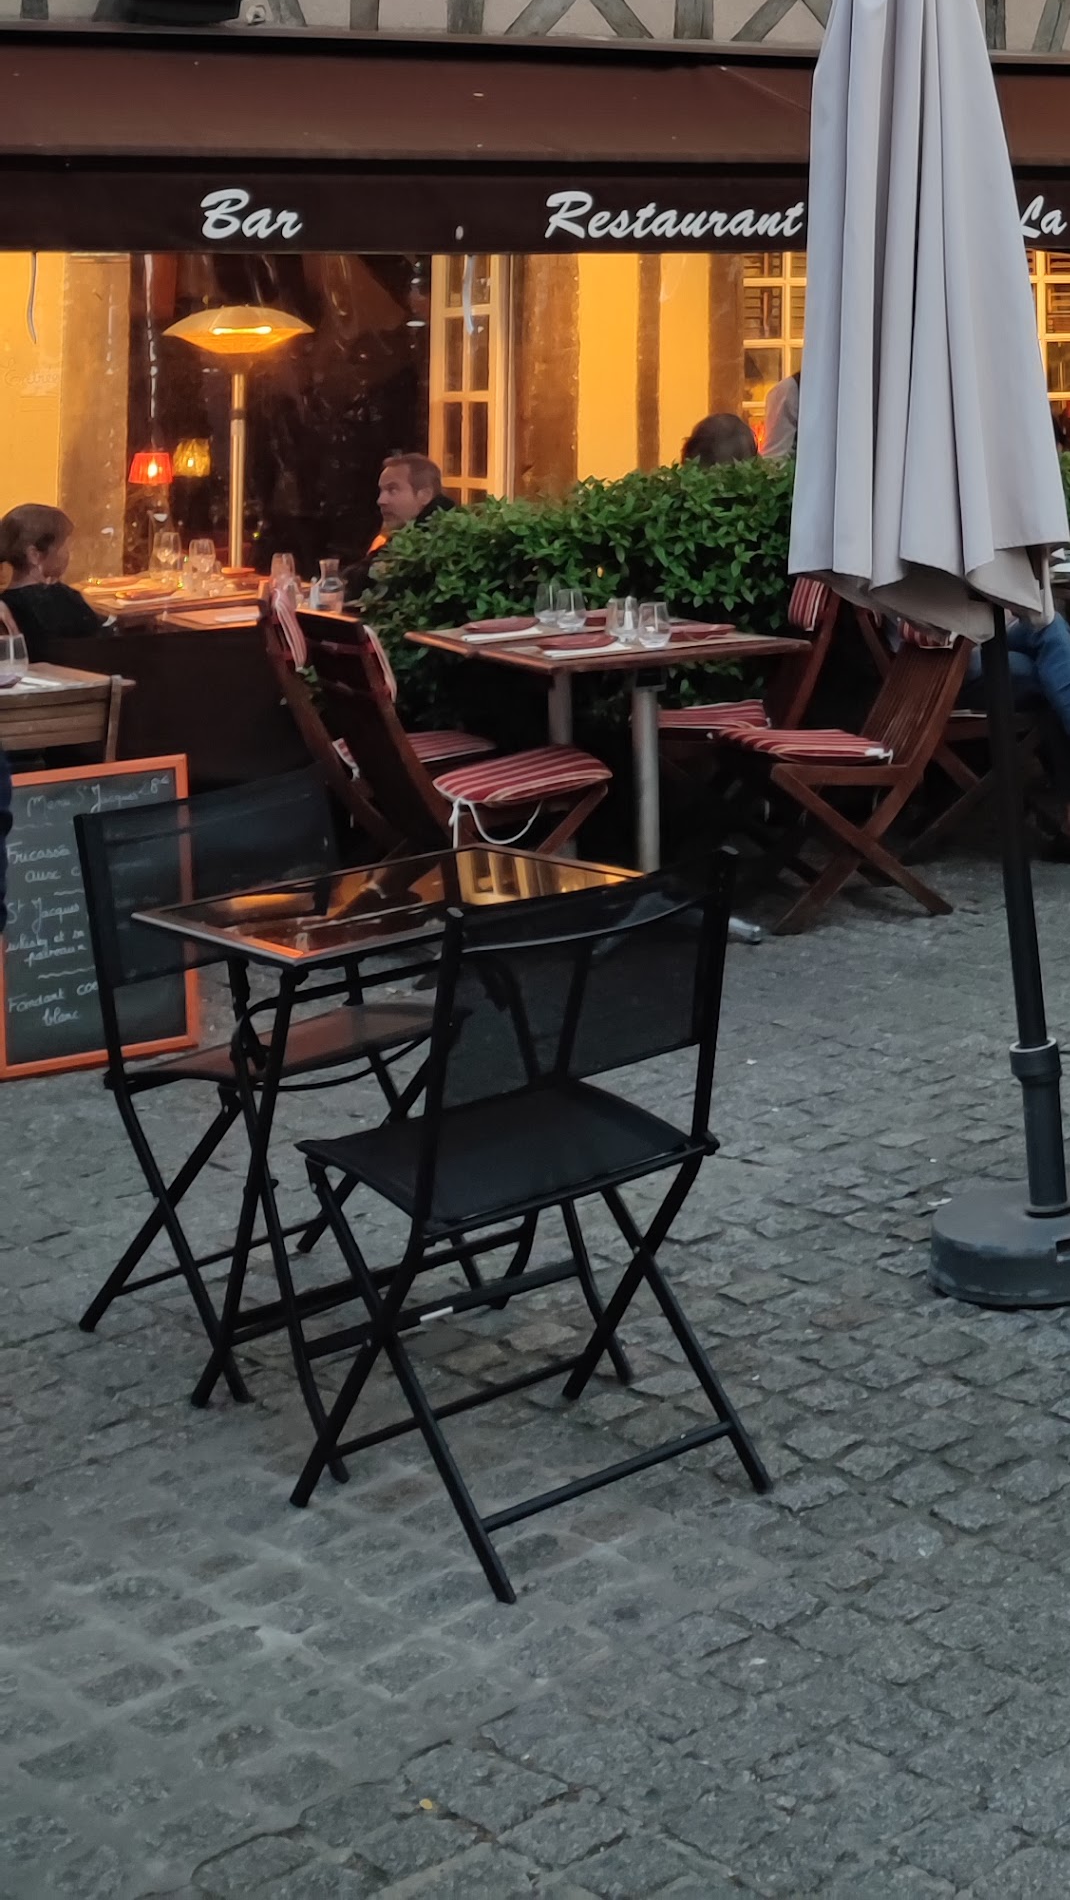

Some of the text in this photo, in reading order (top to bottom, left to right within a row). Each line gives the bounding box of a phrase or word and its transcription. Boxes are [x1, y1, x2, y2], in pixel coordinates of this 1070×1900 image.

[200, 188, 303, 240] Bar
[544, 190, 805, 240] Restaurant
[1020, 195, 1068, 239] La
[31, 897, 80, 934] Jacques
